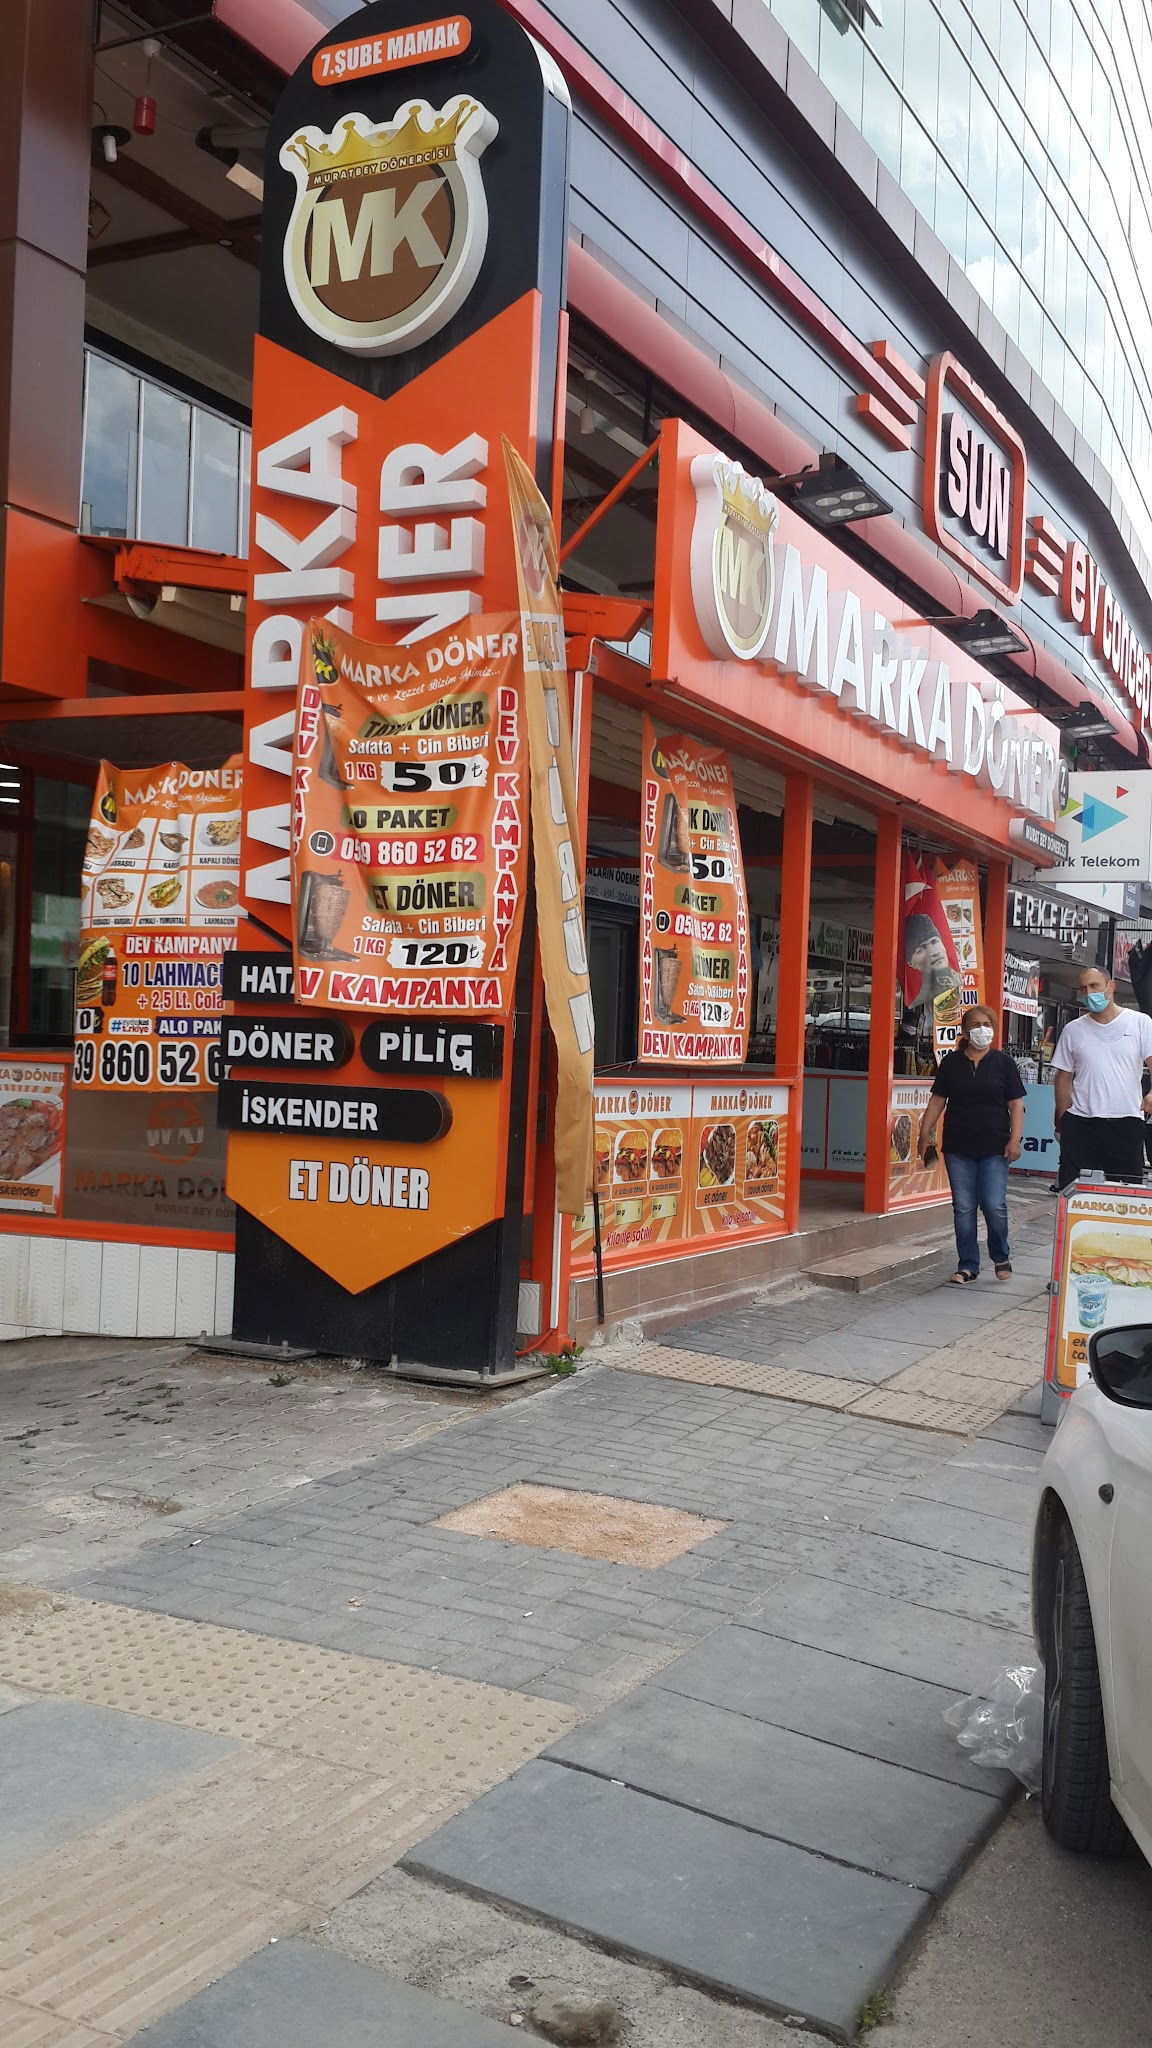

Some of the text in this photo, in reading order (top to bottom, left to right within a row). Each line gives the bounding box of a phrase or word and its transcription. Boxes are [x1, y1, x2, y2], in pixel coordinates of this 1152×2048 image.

[321, 22, 461, 77] 7.ŞUBE MAMAK
[314, 147, 449, 185] MURATBEY DÖNERCİSİ
[311, 177, 448, 287] MK
[947, 411, 1010, 560] SUN
[1070, 540, 1101, 636] ev
[340, 632, 518, 689] MARKA DÖNER
[773, 545, 953, 763] MARKA
[428, 676, 457, 692] Bizim
[298, 684, 322, 758] DEV
[419, 699, 485, 731] DÖNER
[496, 687, 520, 765] DEV
[417, 739, 442, 755] Cin
[447, 732, 489, 753] Biberi
[345, 763, 353, 780] 1
[357, 763, 377, 780] KG
[377, 808, 450, 829] PAKET
[645, 780, 659, 847] DEV
[378, 838, 418, 865] 860
[424, 838, 446, 863] 52
[450, 836, 478, 861] 62
[1080, 856, 1140, 867] Telekom
[488, 772, 521, 971] KAMPANYA
[396, 879, 475, 911] DÖNER
[418, 917, 439, 934] Cin
[443, 915, 487, 934] Biberi
[643, 853, 656, 1025] KAMPANYA
[719, 922, 732, 942] 62
[125, 935, 151, 954] DEV
[353, 936, 362, 953] 1
[365, 936, 386, 956] KG
[733, 873, 748, 1029] KAMPANYA
[122, 961, 223, 988] 10 LAHMAC
[240, 966, 292, 994] HAT
[330, 970, 502, 1008] KAMPANYA
[152, 990, 172, 1012] 2,5
[175, 990, 190, 1009] Lt.
[194, 990, 225, 1010] Cola
[159, 1020, 190, 1035] ALO
[193, 1020, 221, 1035] PAK
[227, 1025, 335, 1062] DÖNER
[642, 1030, 742, 1060] DEV KAMPANYA
[101, 1041, 152, 1084] 860
[158, 1042, 199, 1086] 52
[241, 1089, 378, 1132] İSKENDER
[640, 1092, 672, 1113] DÖNER
[711, 1091, 773, 1111] MARKA DÖNER
[289, 1156, 430, 1210] ET DÖNER
[1072, 1200, 1115, 1213] MARKA
